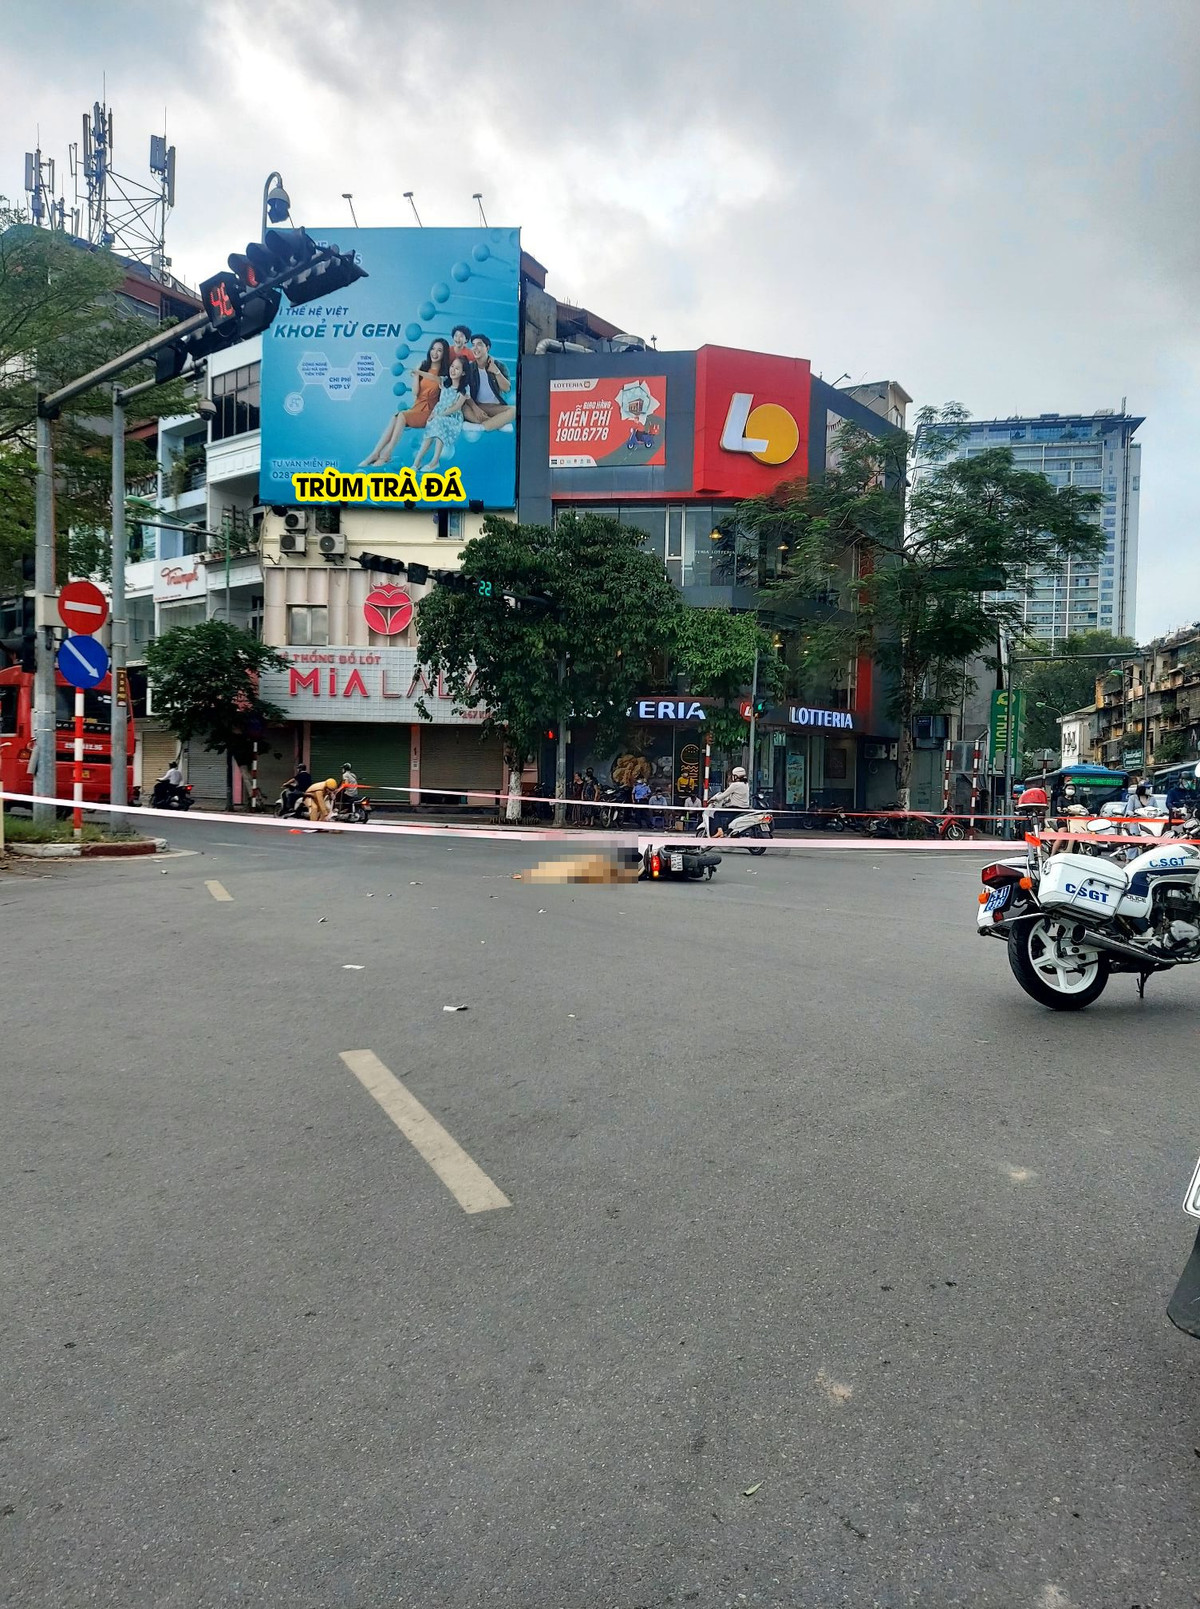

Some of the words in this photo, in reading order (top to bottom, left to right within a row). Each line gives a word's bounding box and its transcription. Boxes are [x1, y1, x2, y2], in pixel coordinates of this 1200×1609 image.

[286, 306, 306, 316] THẾ
[308, 307, 322, 317] HỆ
[325, 307, 349, 317] VIỆT
[332, 321, 358, 338] TỪ
[362, 323, 402, 338] GEN
[341, 375, 351, 383] PHÍ
[557, 404, 589, 427] MIỄN
[590, 406, 614, 426] PHÍ
[555, 427, 609, 442] 1900.6778
[478, 580, 492, 597] 22
[789, 706, 854, 730] LOTTERIA
[1065, 883, 1109, 903] CSGT
